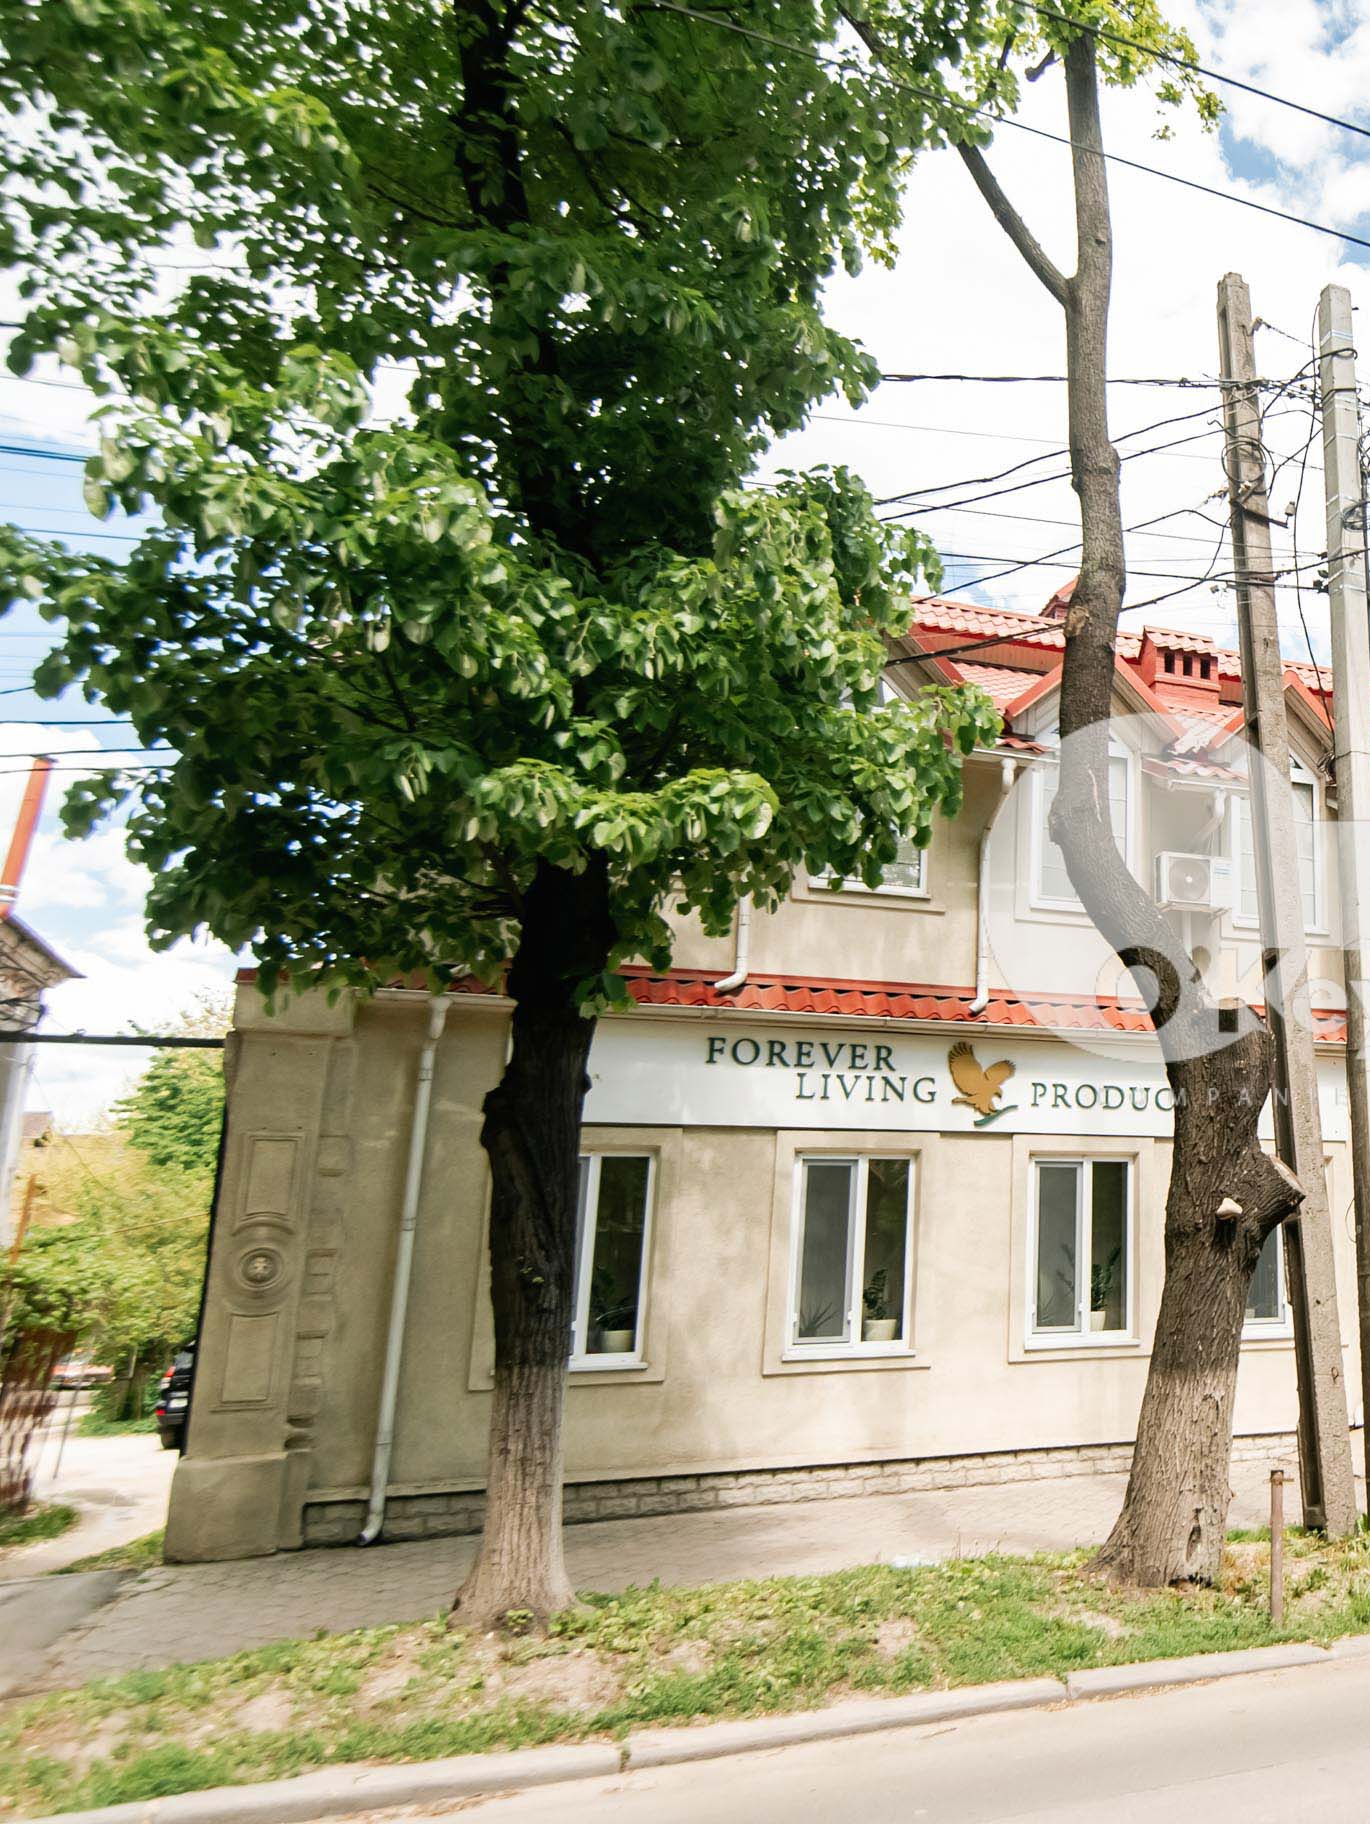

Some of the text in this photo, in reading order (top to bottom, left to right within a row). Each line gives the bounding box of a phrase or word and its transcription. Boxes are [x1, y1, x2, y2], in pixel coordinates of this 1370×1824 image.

[705, 1036, 896, 1072] FOREVER
[795, 1072, 937, 1104] LIVING
[1030, 1081, 1175, 1112] PRODUC
